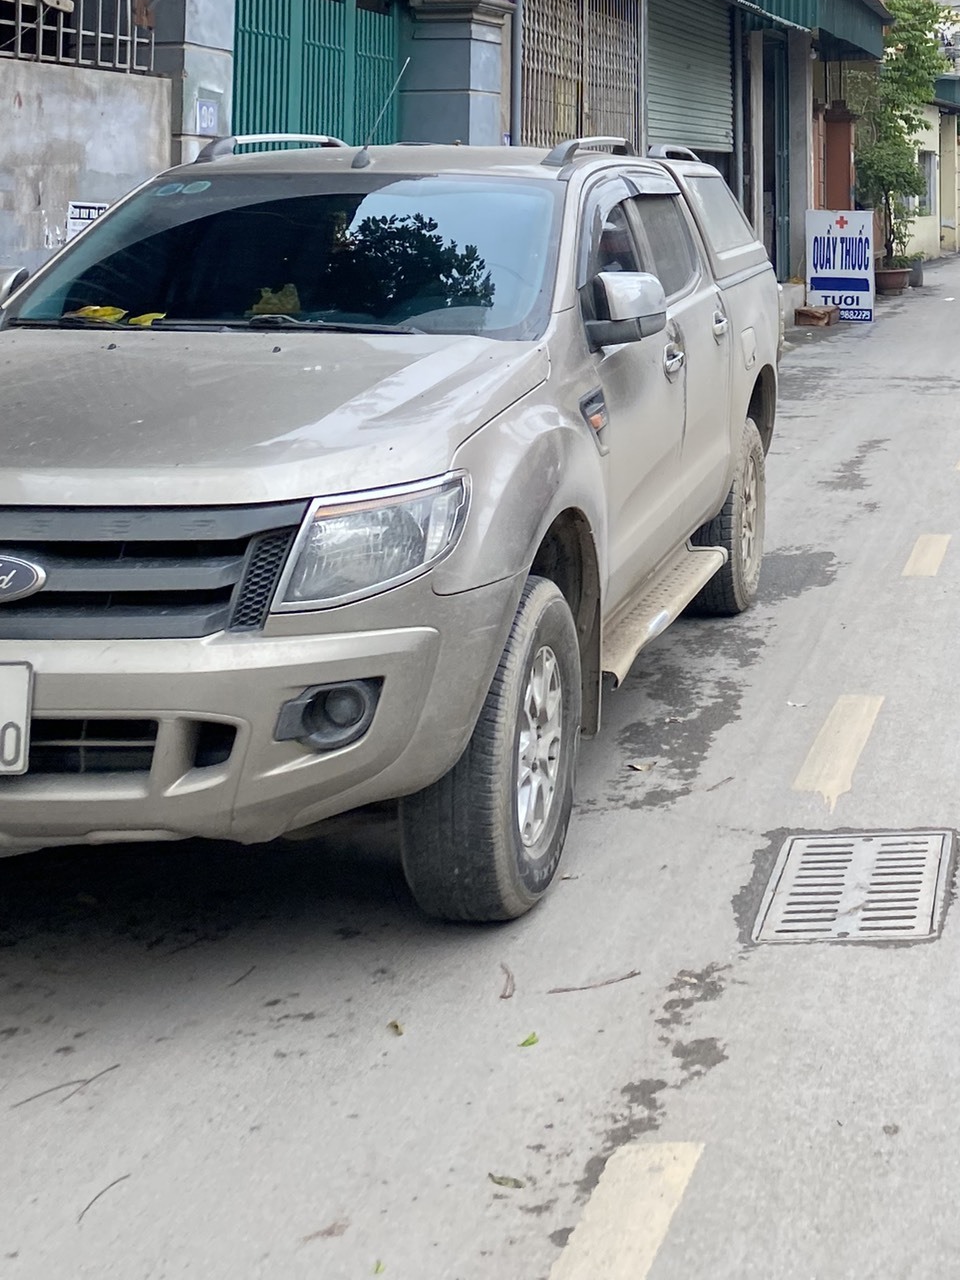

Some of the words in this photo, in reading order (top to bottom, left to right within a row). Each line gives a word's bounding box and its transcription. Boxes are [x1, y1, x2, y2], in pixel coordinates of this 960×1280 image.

[813, 224, 838, 273] QUẦY
[840, 224, 870, 271] THUỐC
[821, 295, 860, 306] TƯƠI
